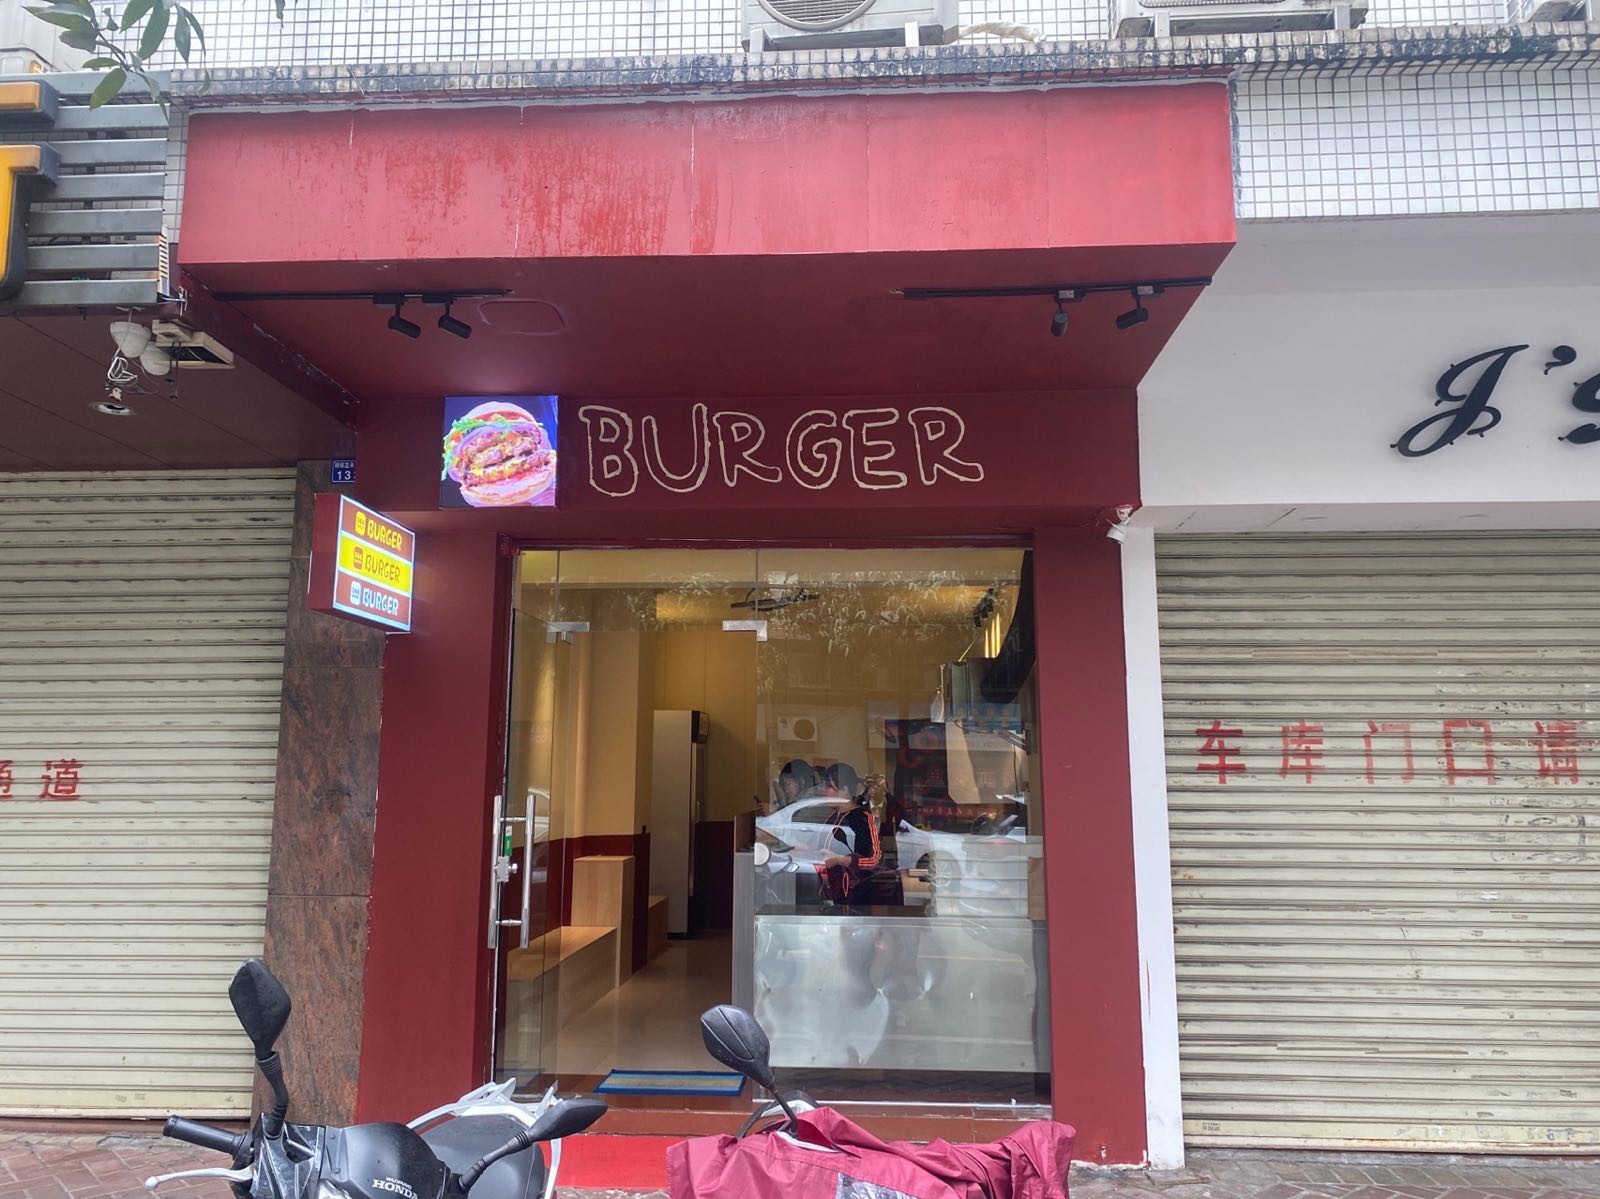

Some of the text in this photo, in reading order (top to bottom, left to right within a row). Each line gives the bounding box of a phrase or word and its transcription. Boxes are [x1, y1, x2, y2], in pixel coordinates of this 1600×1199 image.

[578, 403, 984, 497] BURGER
[337, 470, 356, 480] 13
[367, 519, 402, 551] BURGER
[365, 554, 400, 583] BURGER
[362, 587, 398, 616] BURGER
[372, 1178, 418, 1199] HONDA
